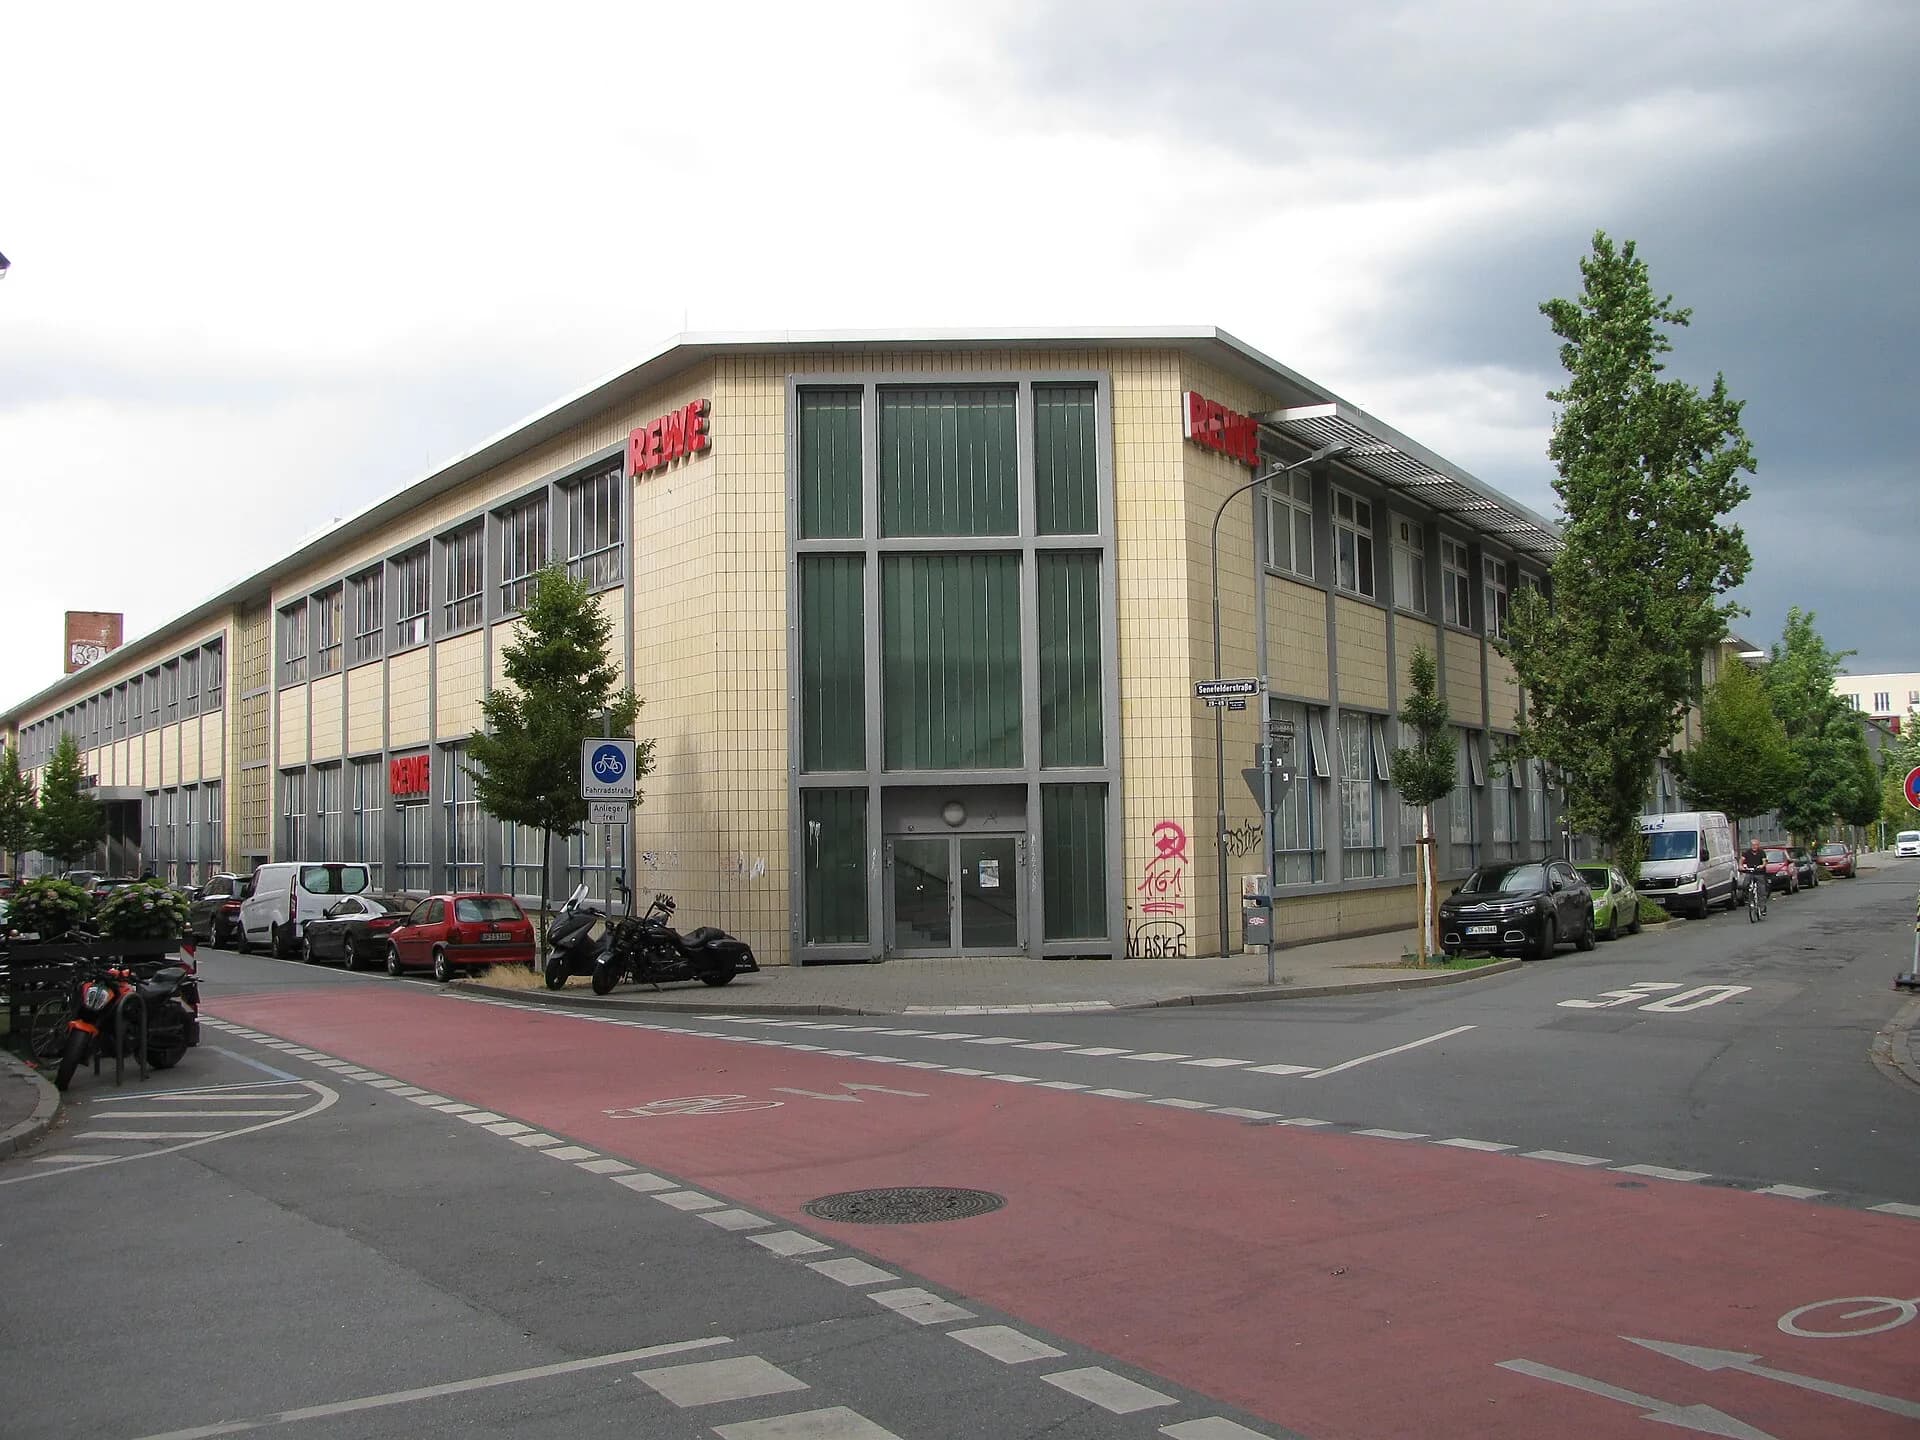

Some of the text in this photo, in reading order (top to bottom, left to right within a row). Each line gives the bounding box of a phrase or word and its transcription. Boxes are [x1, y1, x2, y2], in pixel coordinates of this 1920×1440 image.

[1184, 390, 1260, 466] REWE
[629, 399, 711, 477] REWE
[1198, 683, 1252, 694] Senefelderstraße
[390, 755, 430, 795] REWE
[585, 786, 632, 794] Fahrradstraße
[594, 804, 624, 813] Anlieger
[603, 813, 616, 821] frei
[1641, 823, 1664, 832] GLS
[1557, 982, 1752, 1012] 30
